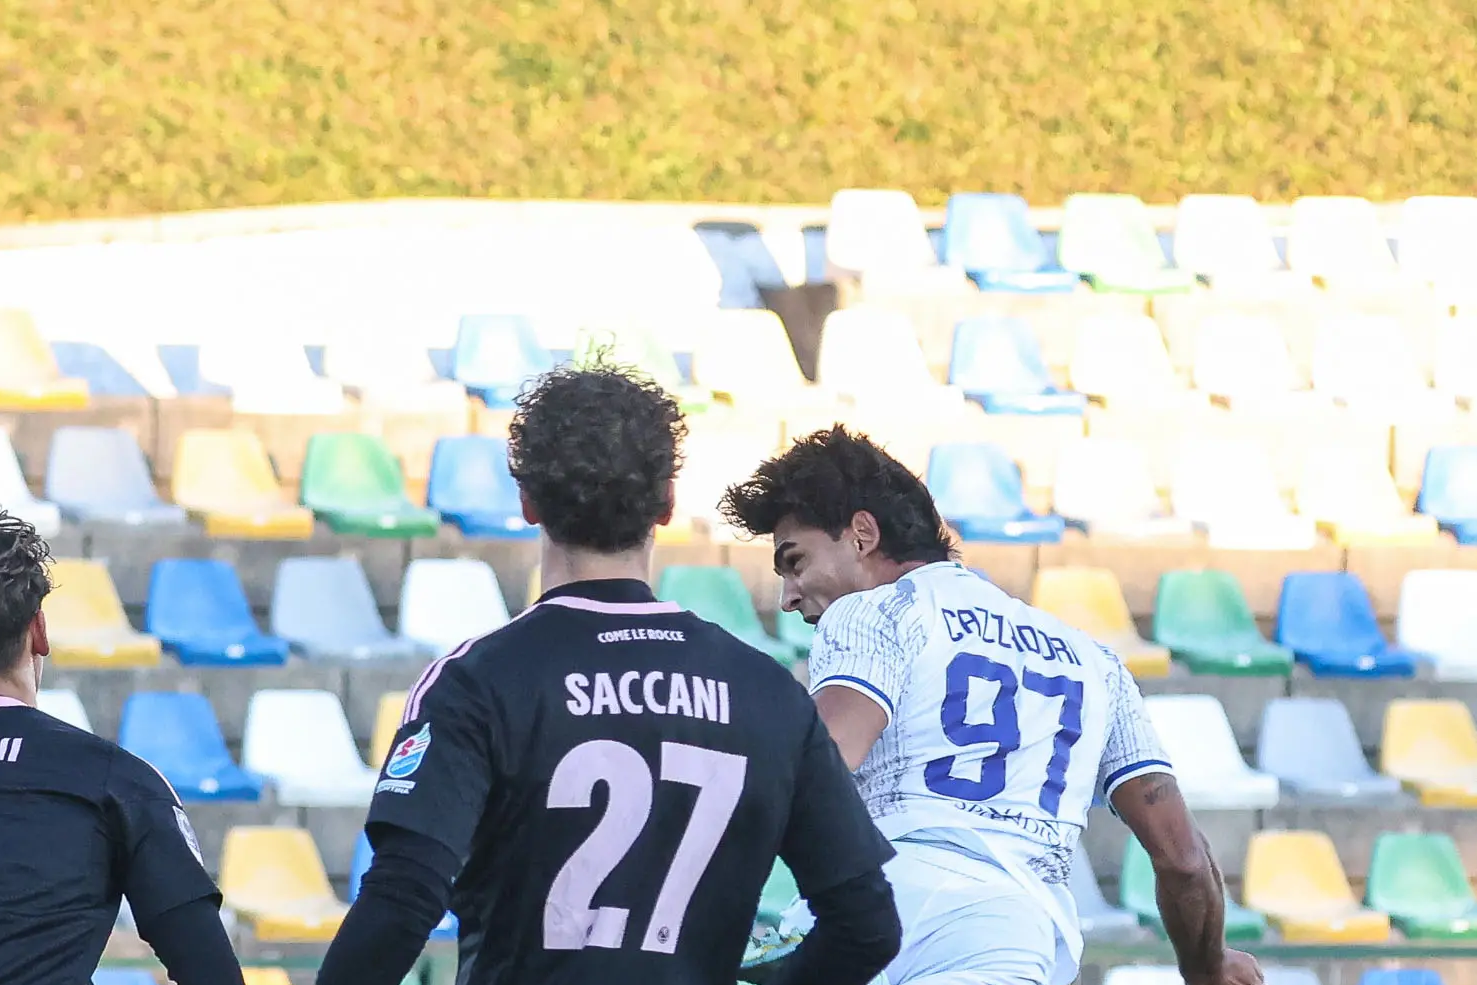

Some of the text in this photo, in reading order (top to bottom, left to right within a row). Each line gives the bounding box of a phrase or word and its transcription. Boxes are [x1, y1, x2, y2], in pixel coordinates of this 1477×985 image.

[597, 628, 632, 643] COME
[631, 628, 647, 640] LE
[564, 670, 731, 724] SACCANI
[923, 651, 1084, 819] 97
[542, 739, 749, 955] 27
